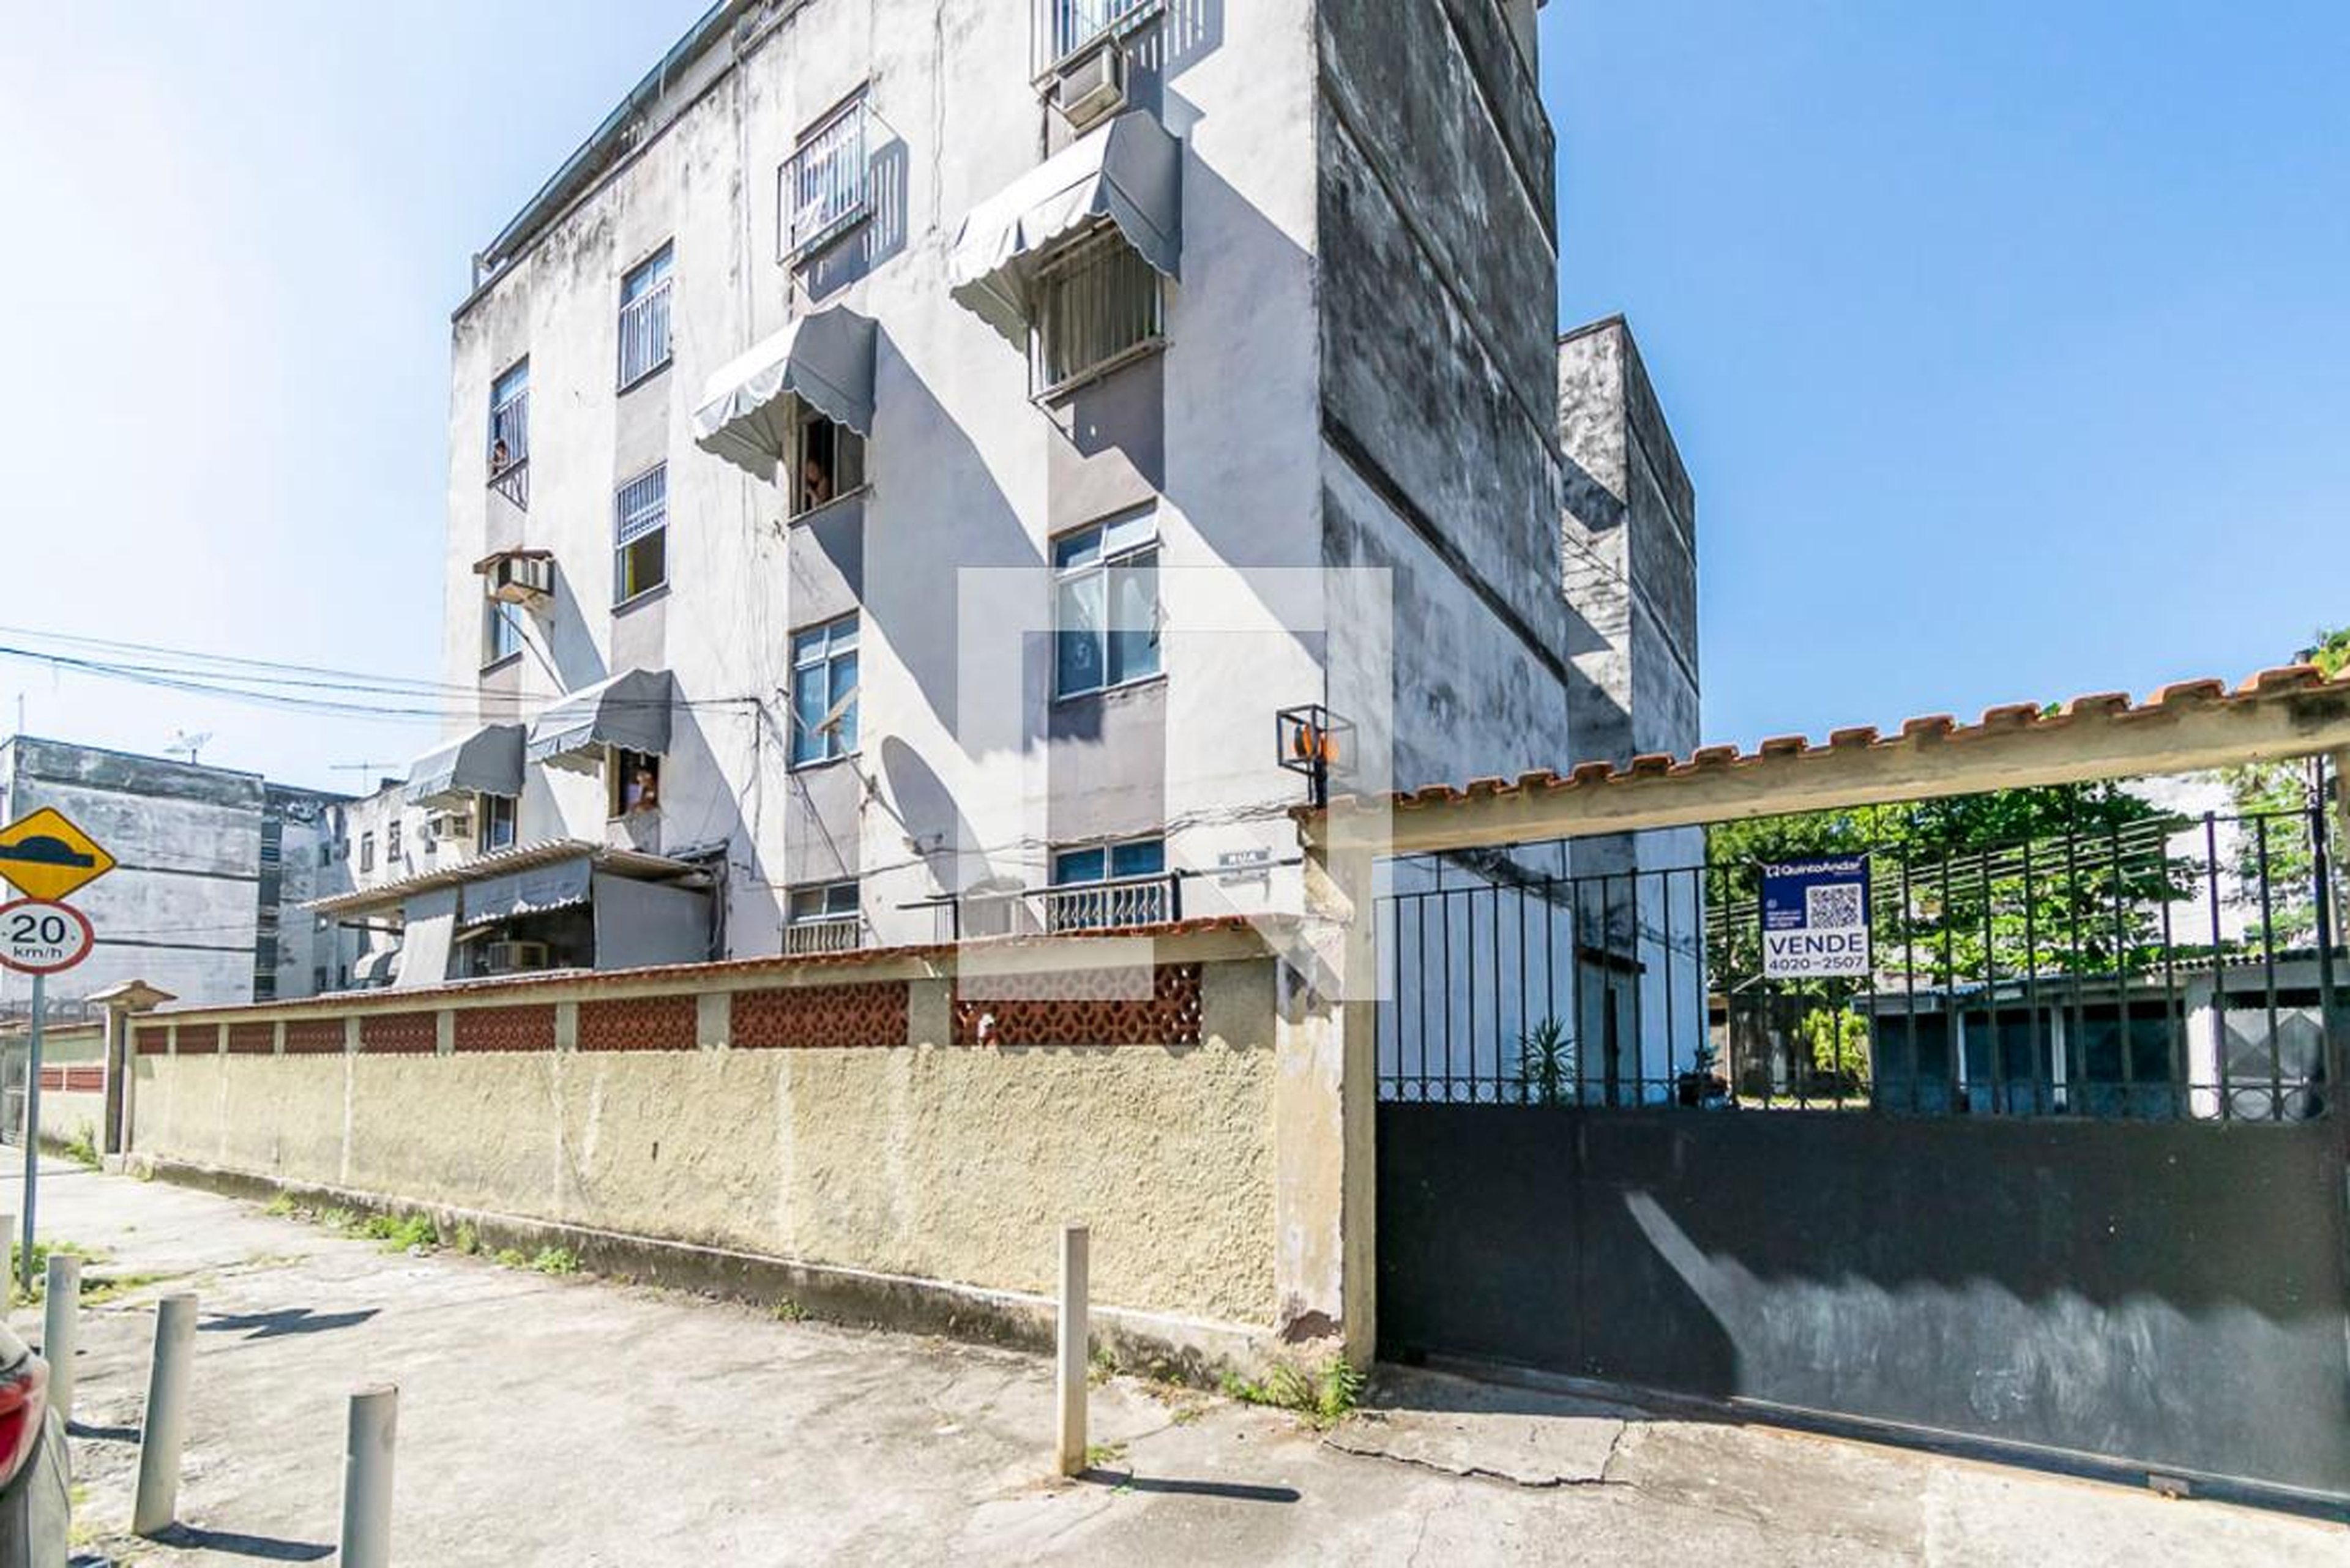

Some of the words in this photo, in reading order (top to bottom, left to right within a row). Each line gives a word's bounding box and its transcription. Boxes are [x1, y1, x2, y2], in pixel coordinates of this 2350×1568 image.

[12, 914, 65, 944] 20
[13, 946, 62, 958] km/h
[1769, 933, 1863, 955] VENDE
[1769, 956, 1864, 969] 4020-2507
